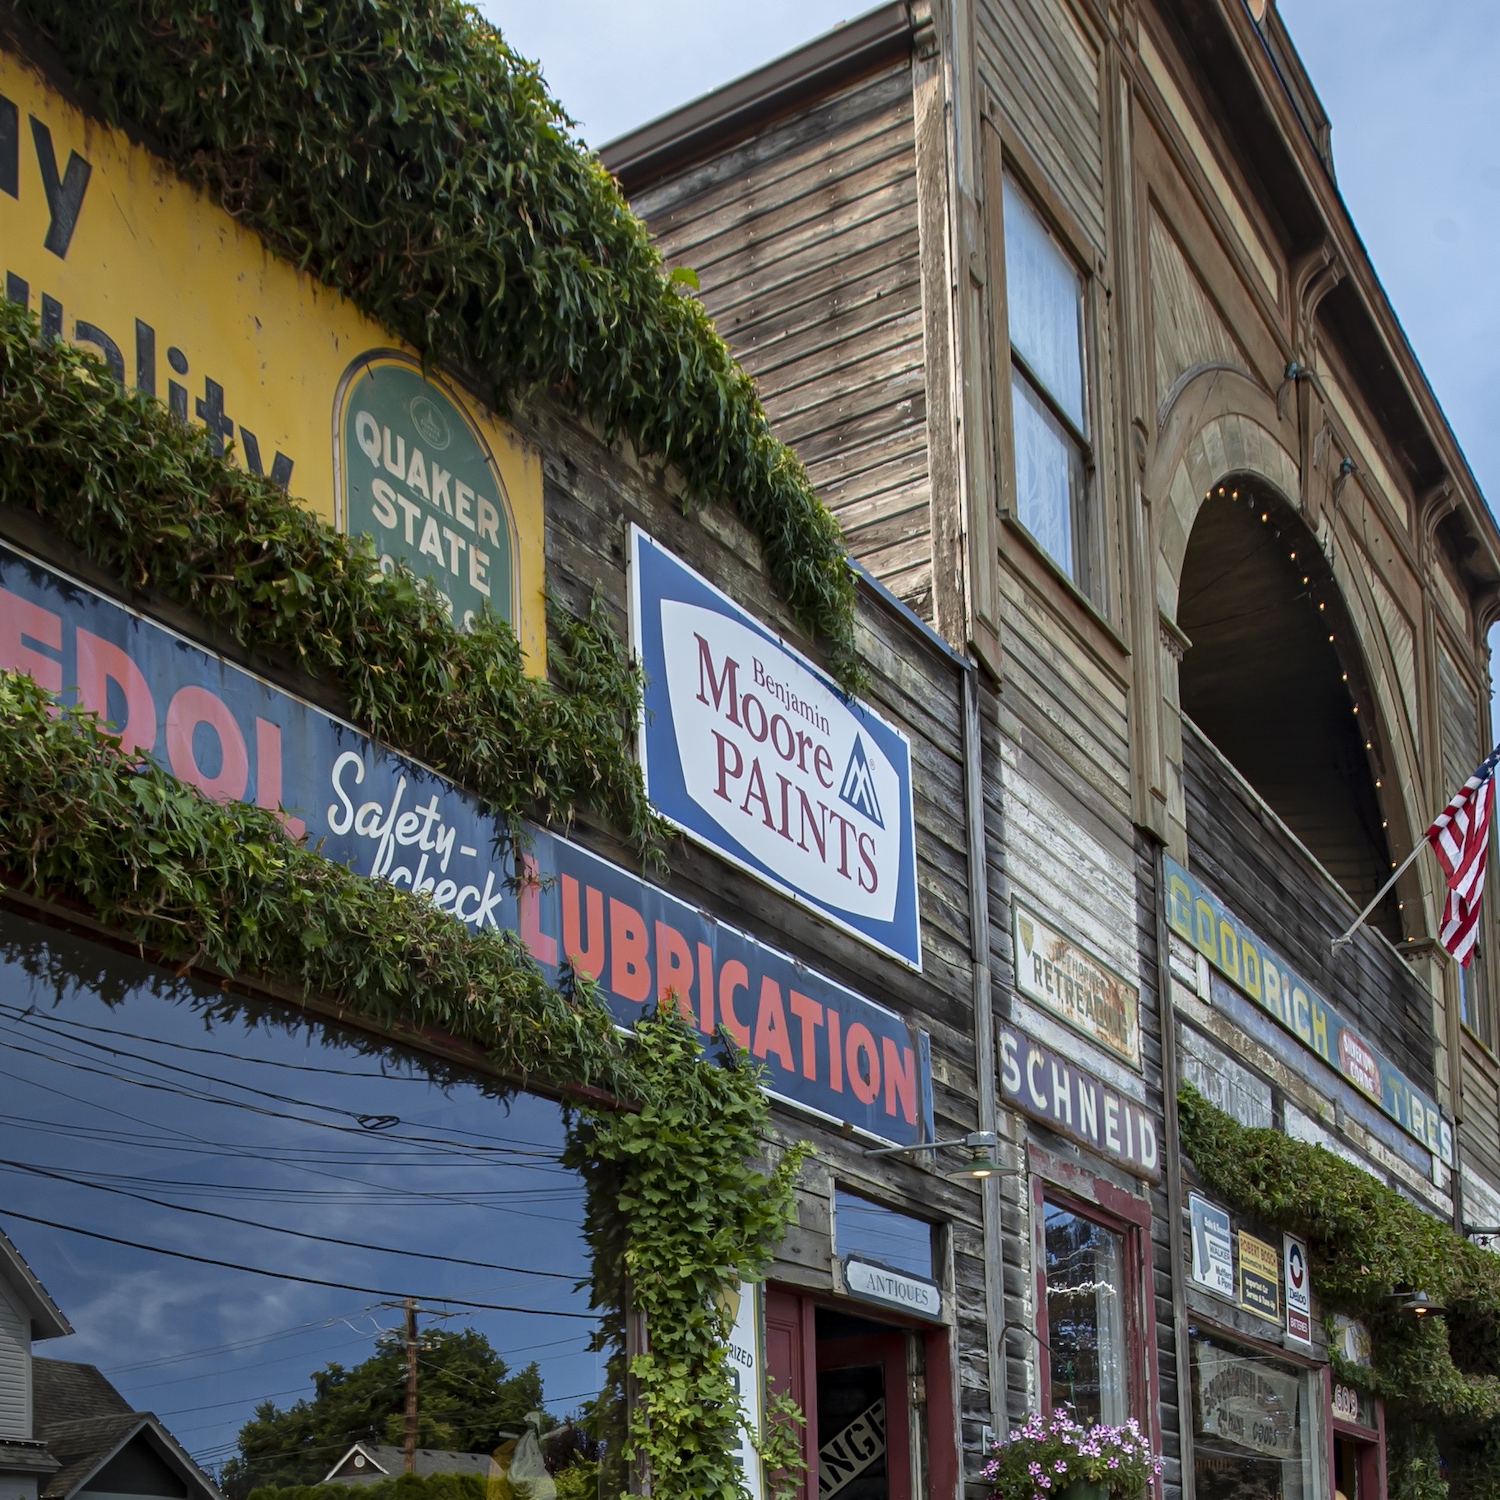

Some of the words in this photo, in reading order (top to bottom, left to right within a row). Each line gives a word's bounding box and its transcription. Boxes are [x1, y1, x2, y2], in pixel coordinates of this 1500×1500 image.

[355, 410, 500, 549] QUAKER
[371, 477, 491, 597] STATE
[693, 631, 834, 789] Moore
[751, 655, 831, 737] Benjamin
[710, 728, 878, 894] PAINTS
[389, 853, 503, 932] check
[520, 852, 918, 1126] LUBRICATION
[1169, 872, 1330, 1061] GOODRICH
[1000, 1031, 1157, 1170] SCHNEID
[1389, 1075, 1453, 1166] TIRES
[866, 1272, 929, 1306] ANTIQUES
[1209, 1243, 1230, 1260] WALKER
[1261, 1247, 1276, 1267] BOSCH
[1289, 1287, 1306, 1306] Delco
[1334, 1384, 1358, 1420] 609
